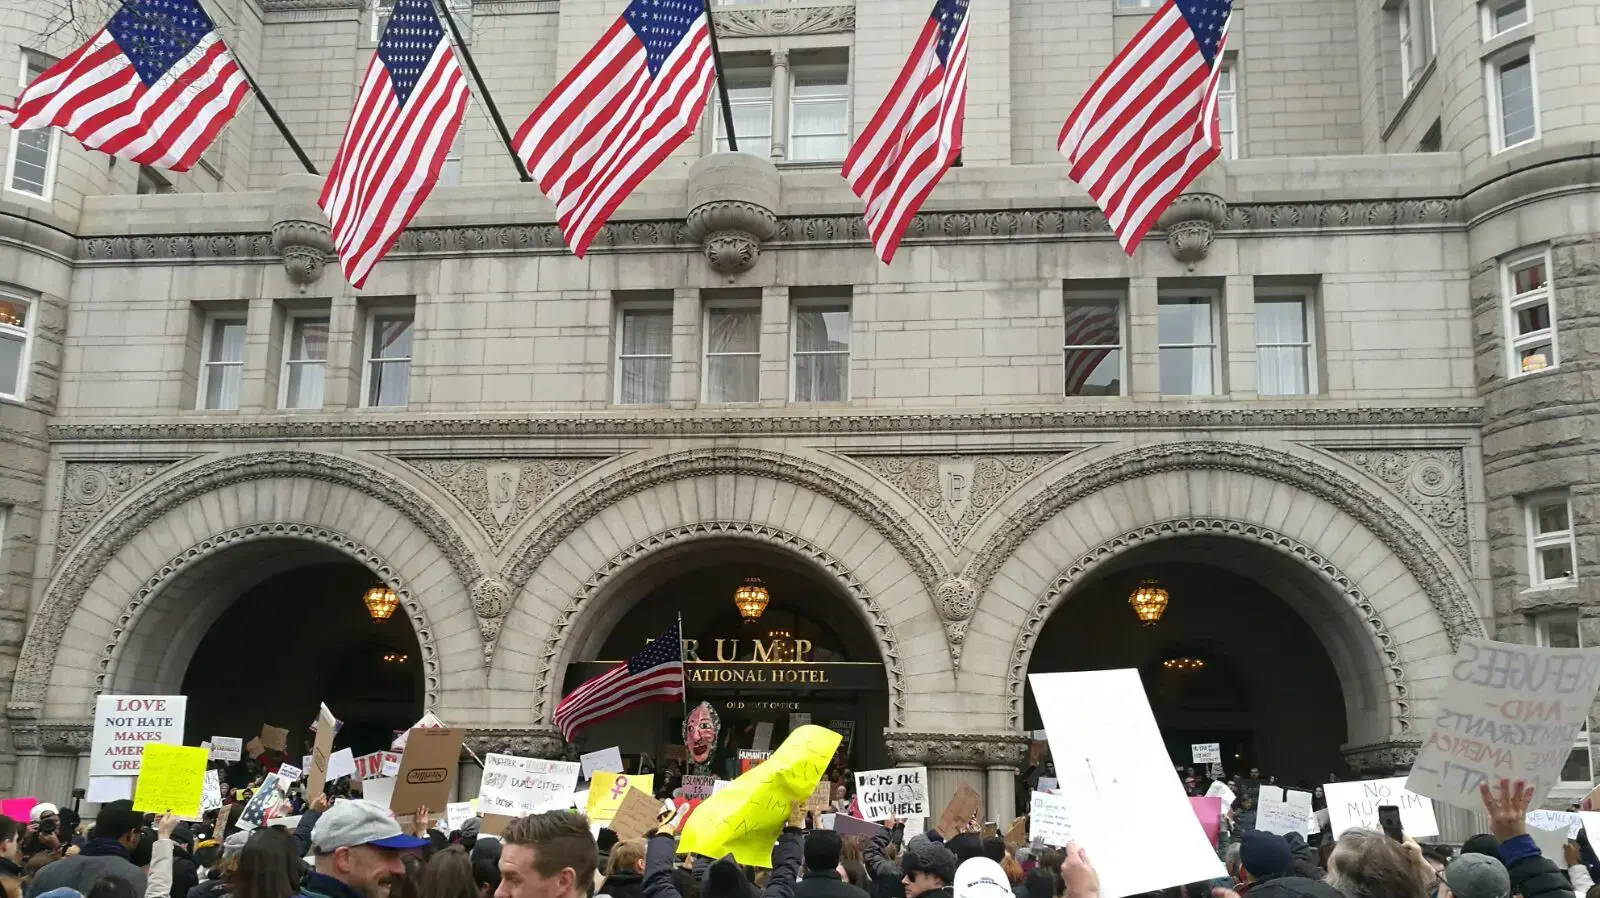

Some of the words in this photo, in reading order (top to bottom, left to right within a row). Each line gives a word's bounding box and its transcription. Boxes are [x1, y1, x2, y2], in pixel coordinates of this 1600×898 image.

[646, 638, 812, 662] RUMP
[685, 669, 767, 682] NATIONAL
[771, 669, 829, 683] HOTEL
[115, 699, 166, 711] LOVE
[726, 701, 745, 709] OLD
[105, 717, 134, 727] NOT
[137, 717, 173, 727] HATE
[114, 731, 162, 741] MAKES
[104, 746, 144, 756] AMER
[738, 750, 772, 760] HUMANITY
[112, 760, 140, 770] GRE
[682, 774, 714, 787] ISLAMOPHO
[897, 771, 920, 785] not
